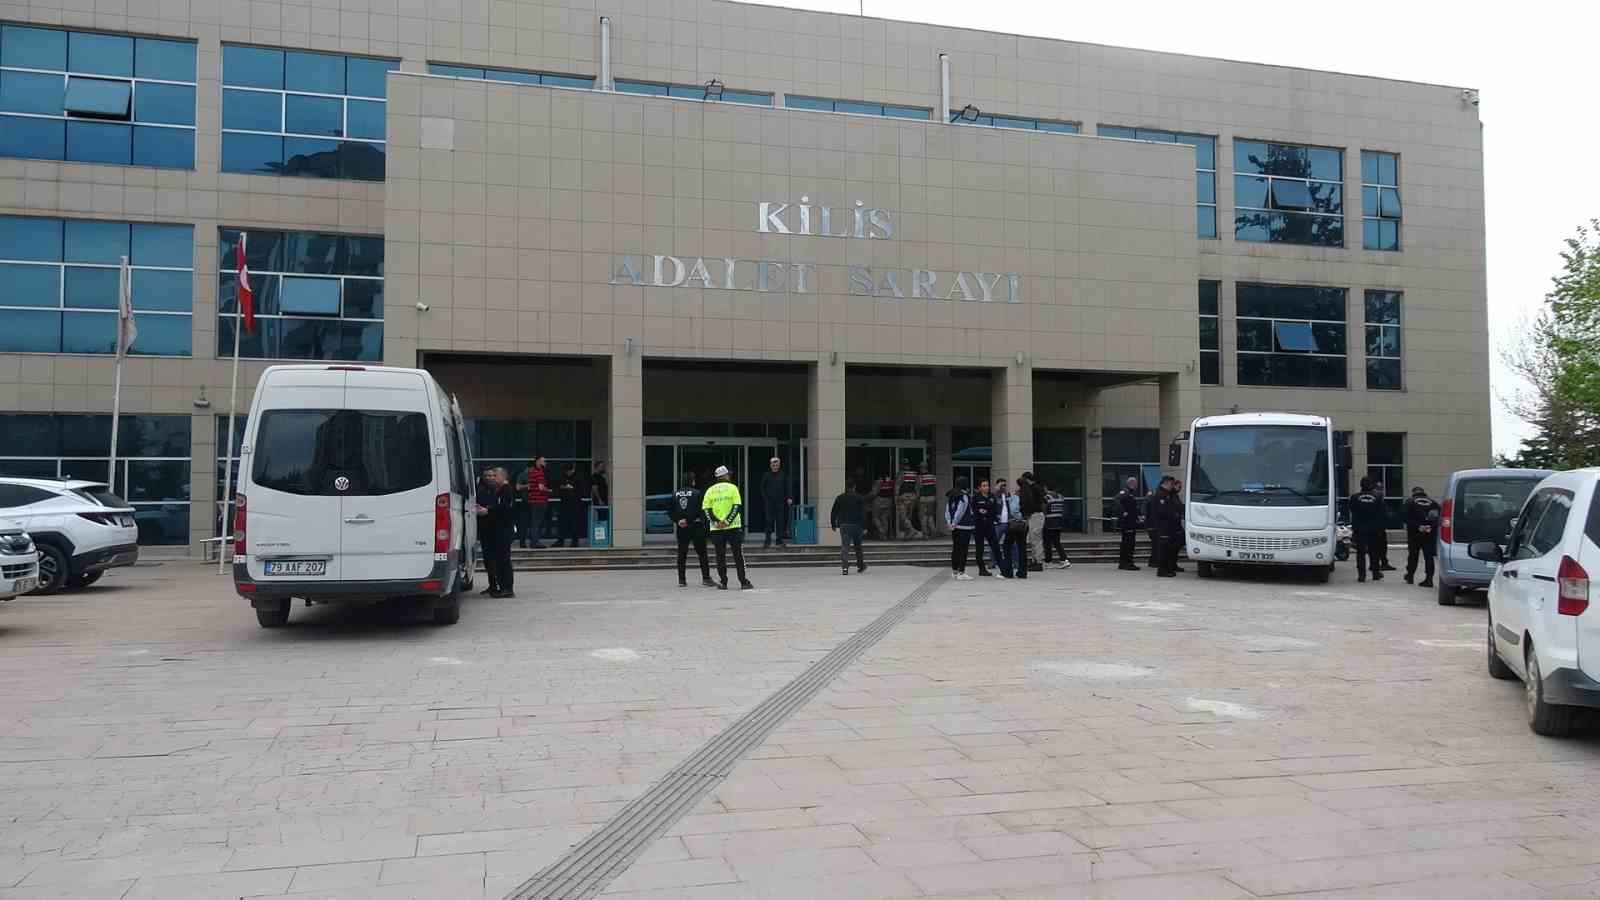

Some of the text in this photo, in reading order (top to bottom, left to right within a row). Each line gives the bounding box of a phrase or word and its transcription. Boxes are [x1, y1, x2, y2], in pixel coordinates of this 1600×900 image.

[756, 195, 895, 240] KİLİS
[608, 255, 1022, 303] ADALET SARAYI
